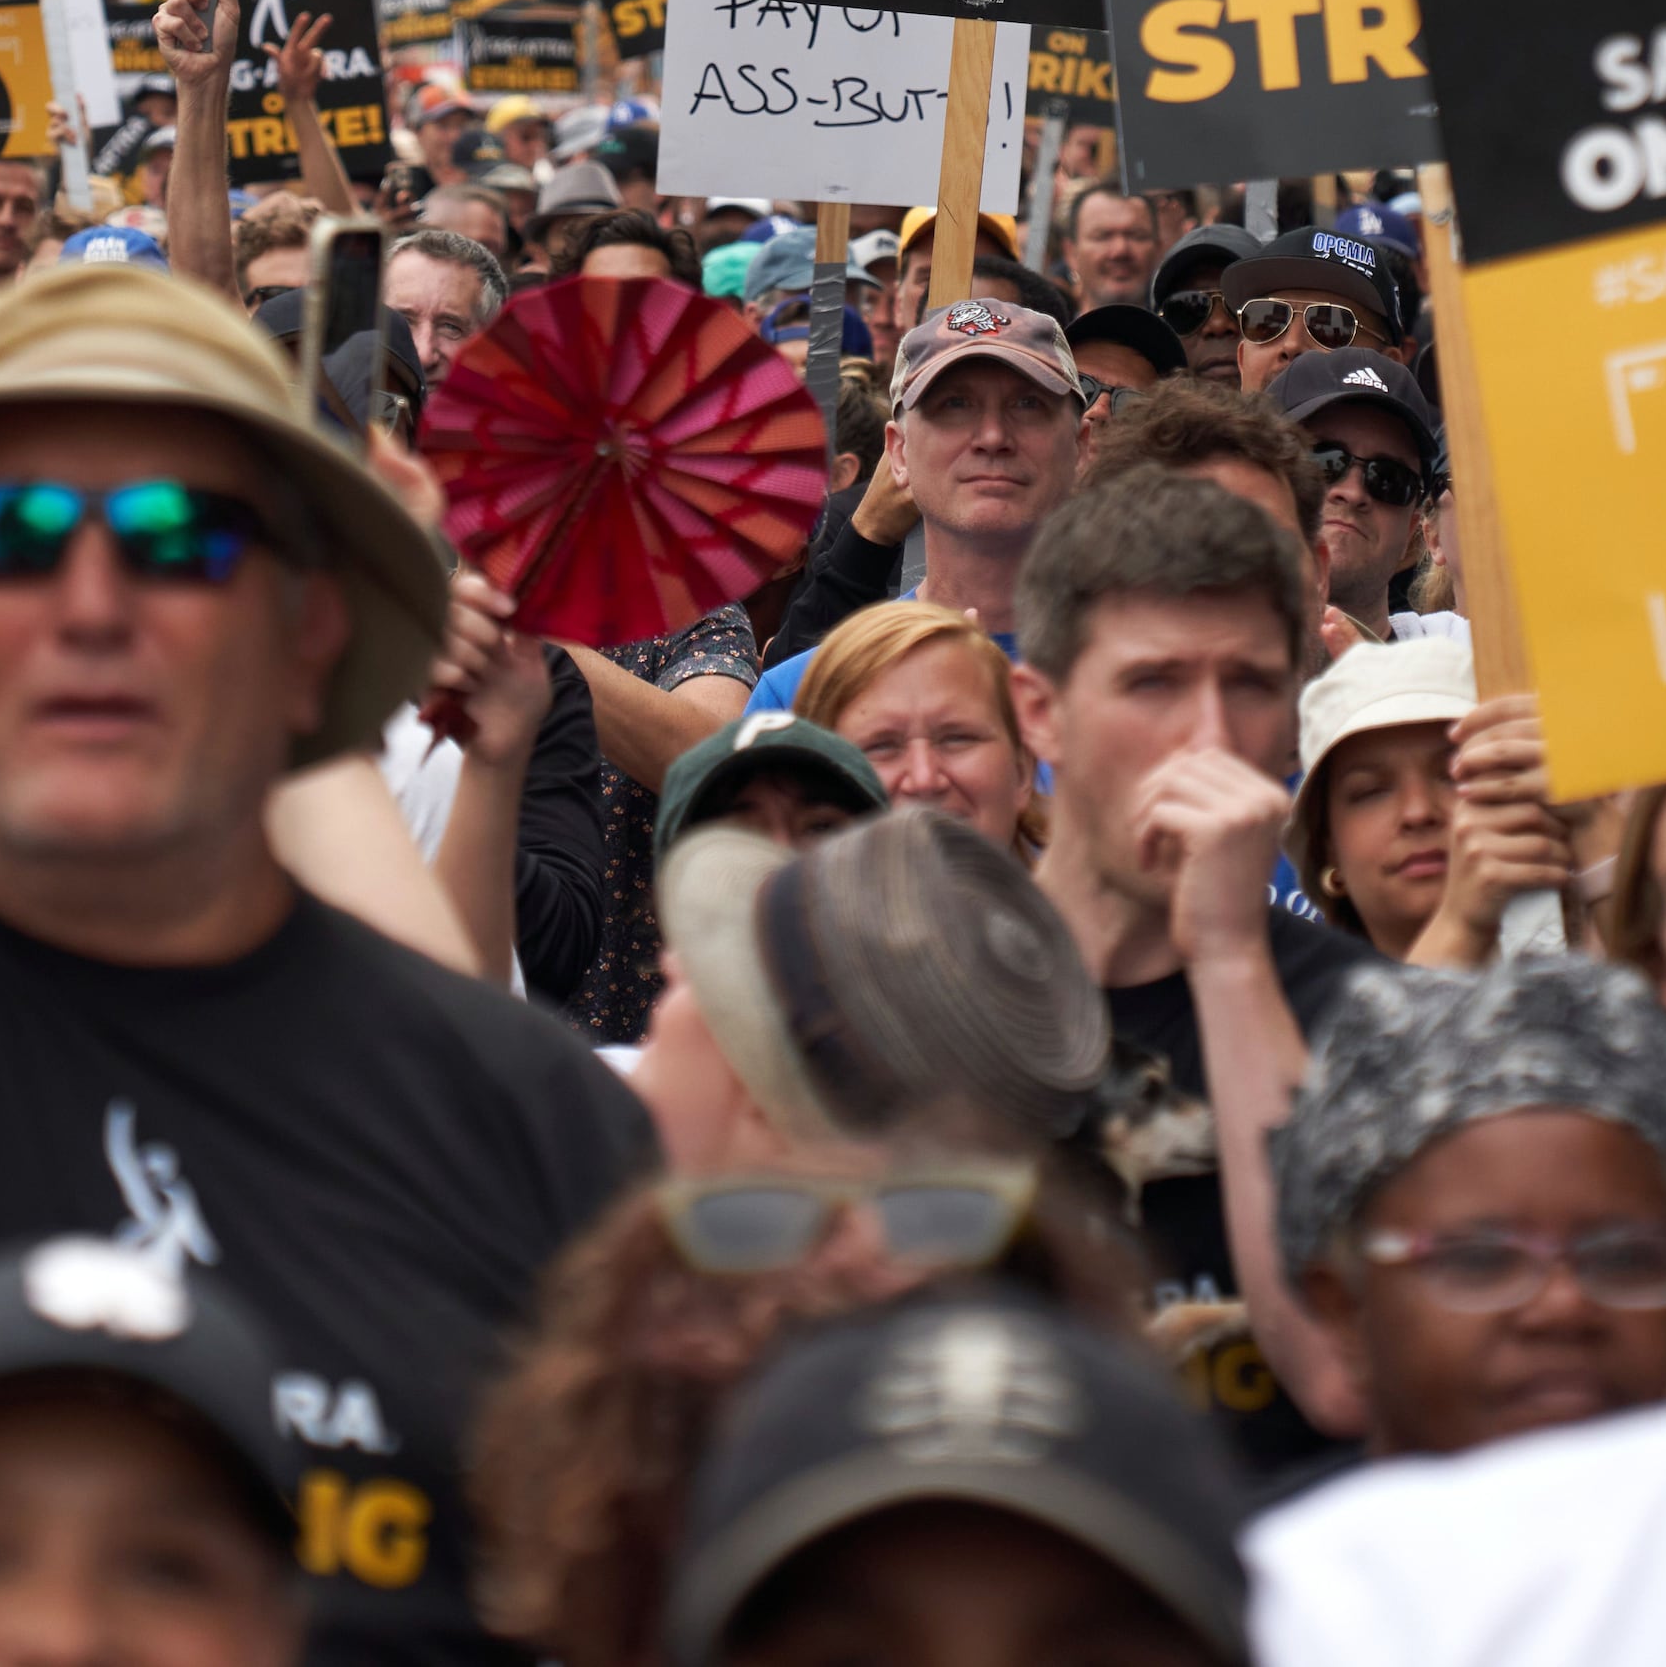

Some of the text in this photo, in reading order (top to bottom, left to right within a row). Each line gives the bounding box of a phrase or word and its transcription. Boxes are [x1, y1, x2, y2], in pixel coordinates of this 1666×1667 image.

[1047, 30, 1087, 55] ON
[1313, 232, 1376, 268] OPCMIA
[1342, 376, 1389, 393] adidas
